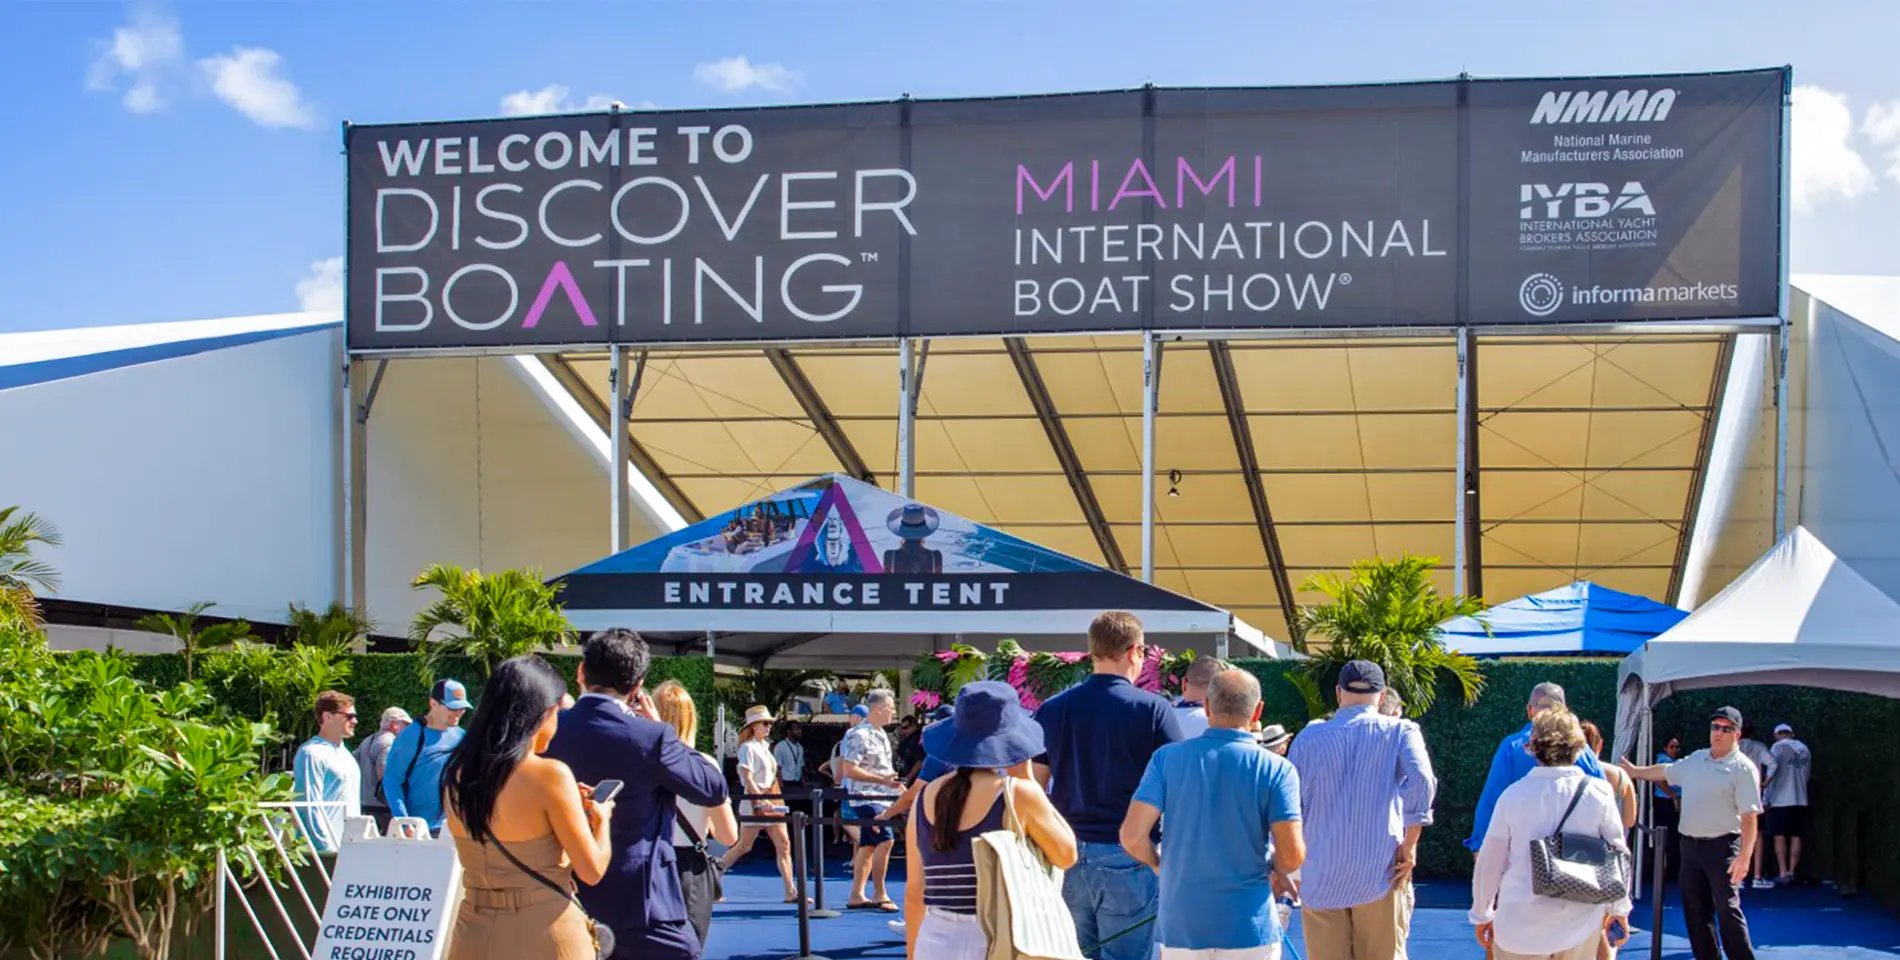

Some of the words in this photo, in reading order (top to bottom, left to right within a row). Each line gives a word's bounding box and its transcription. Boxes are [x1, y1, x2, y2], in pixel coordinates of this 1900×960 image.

[1554, 134, 1605, 148] National
[1609, 132, 1652, 146] Marine
[378, 127, 658, 177] WELCOME
[678, 124, 754, 165] TO
[1521, 149, 1610, 163] Manufacturers
[1613, 147, 1684, 161] Association
[1016, 155, 1263, 215] MIAMI
[1520, 181, 1657, 219] IYBA
[375, 168, 918, 253] DISCOVER
[1520, 219, 1613, 231] INTERNATIONAL
[1617, 217, 1657, 229] YACHT
[1015, 219, 1447, 265] INTERNATIONAL
[1520, 232, 1572, 244] BROKERS
[1575, 229, 1657, 243] ASSOCIATION
[1015, 275, 1150, 316] BOAT
[664, 581, 881, 605] ENTRANCE
[904, 582, 1011, 605] TENT
[344, 884, 432, 901] EXHIBITOR
[337, 905, 380, 920] GATE
[384, 907, 432, 922] ONLY
[323, 925, 434, 944] CREDENTIALS
[330, 946, 416, 960] REQUIRED
